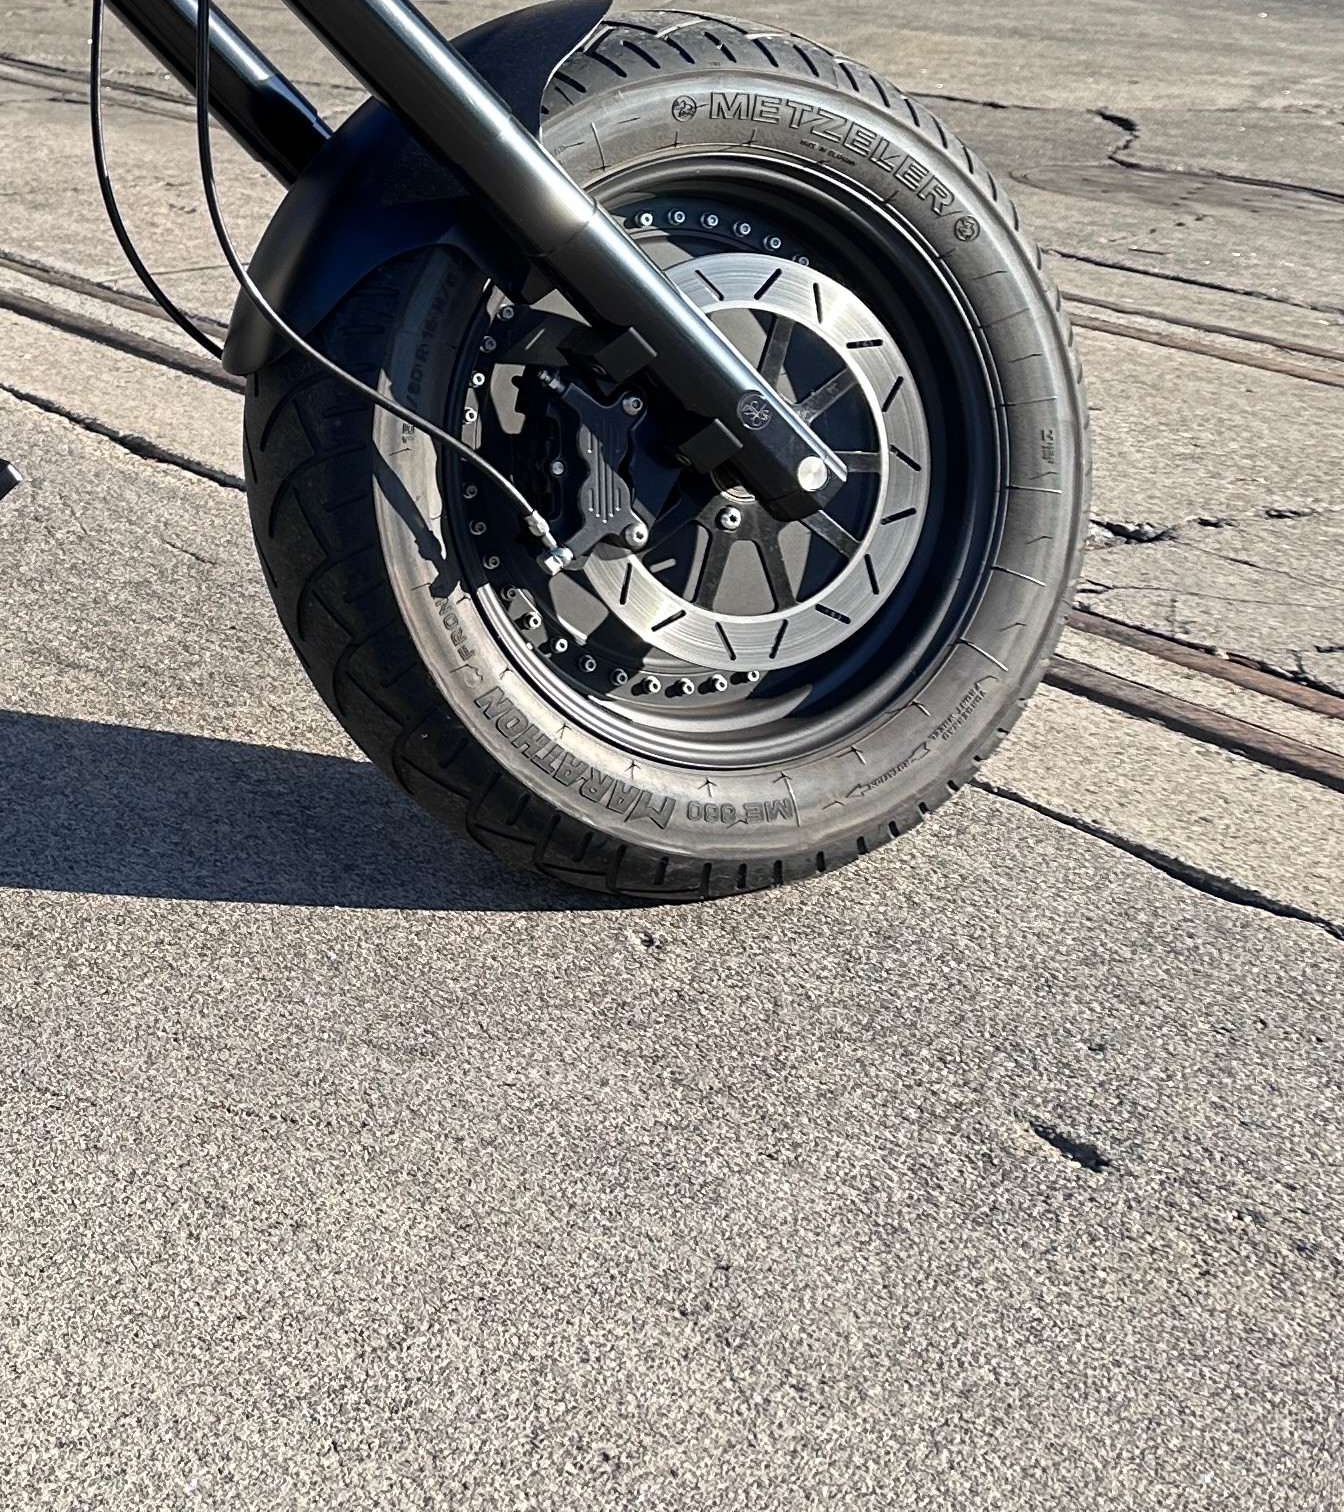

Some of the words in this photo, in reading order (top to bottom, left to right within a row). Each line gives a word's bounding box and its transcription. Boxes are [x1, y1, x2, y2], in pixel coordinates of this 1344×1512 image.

[710, 91, 957, 218] METZELER
[430, 586, 475, 662] FRON
[473, 685, 677, 830] MARATHON
[743, 798, 795, 825] ME
